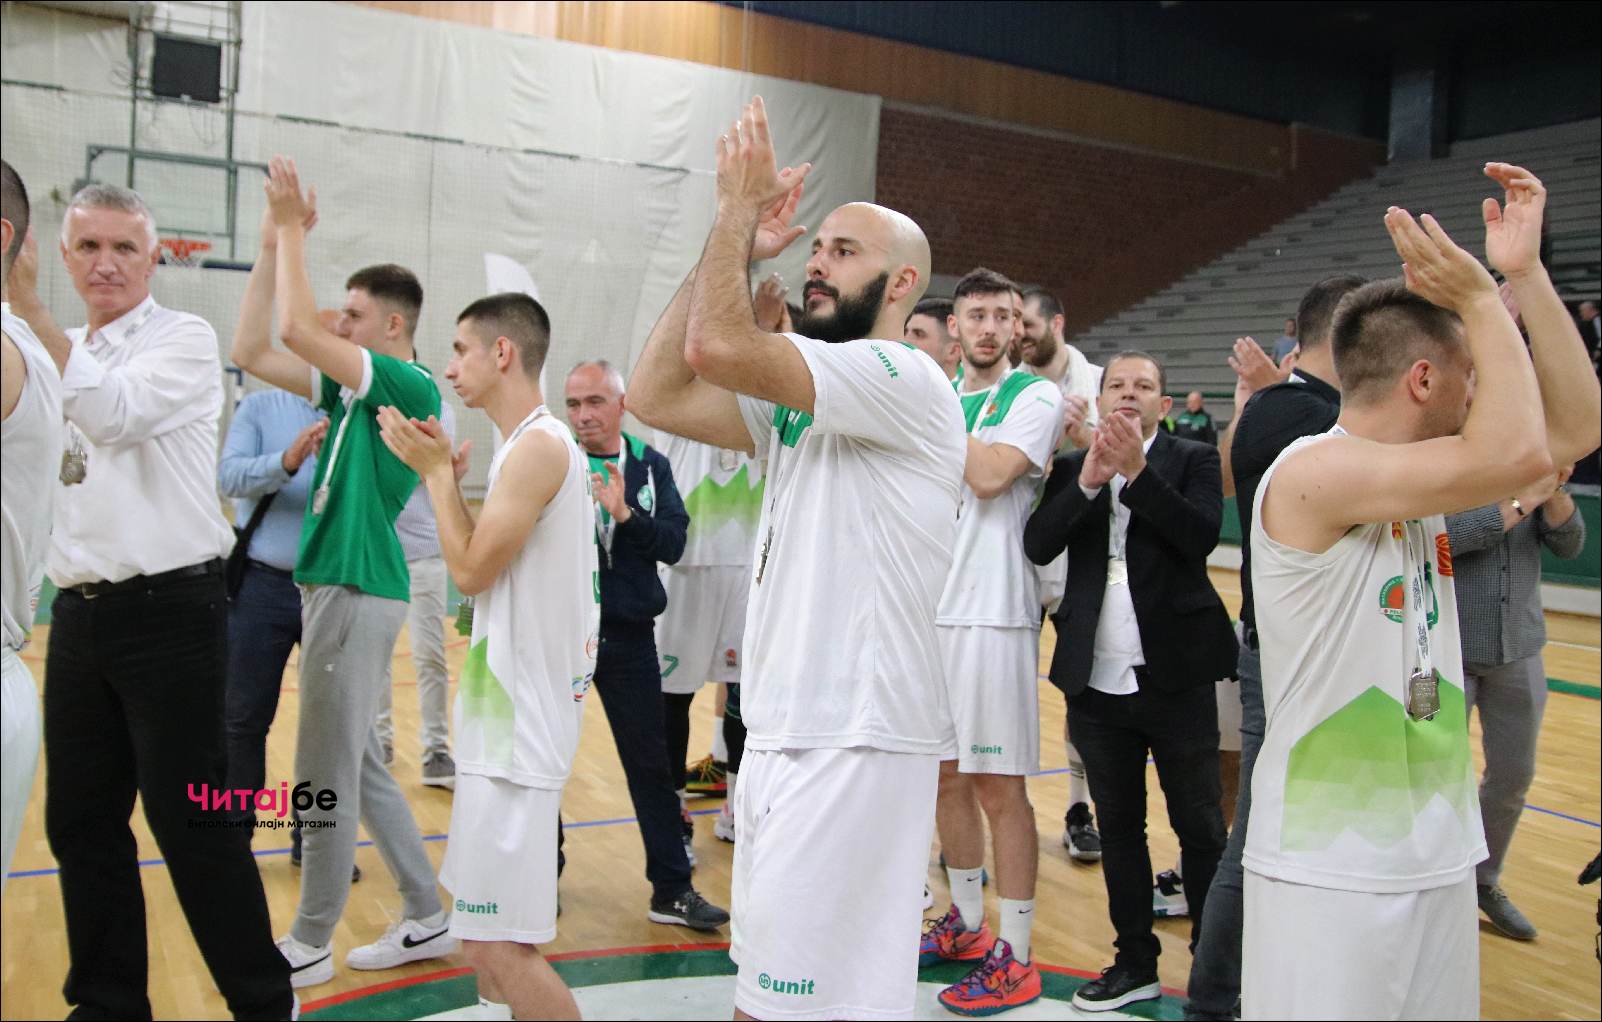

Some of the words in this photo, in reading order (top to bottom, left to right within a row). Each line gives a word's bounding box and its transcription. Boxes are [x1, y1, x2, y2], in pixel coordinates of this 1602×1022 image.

[878, 351, 898, 379] unit
[661, 654, 679, 679] 7
[979, 744, 1003, 755] unit
[466, 901, 499, 914] unit
[772, 978, 815, 995] unit
